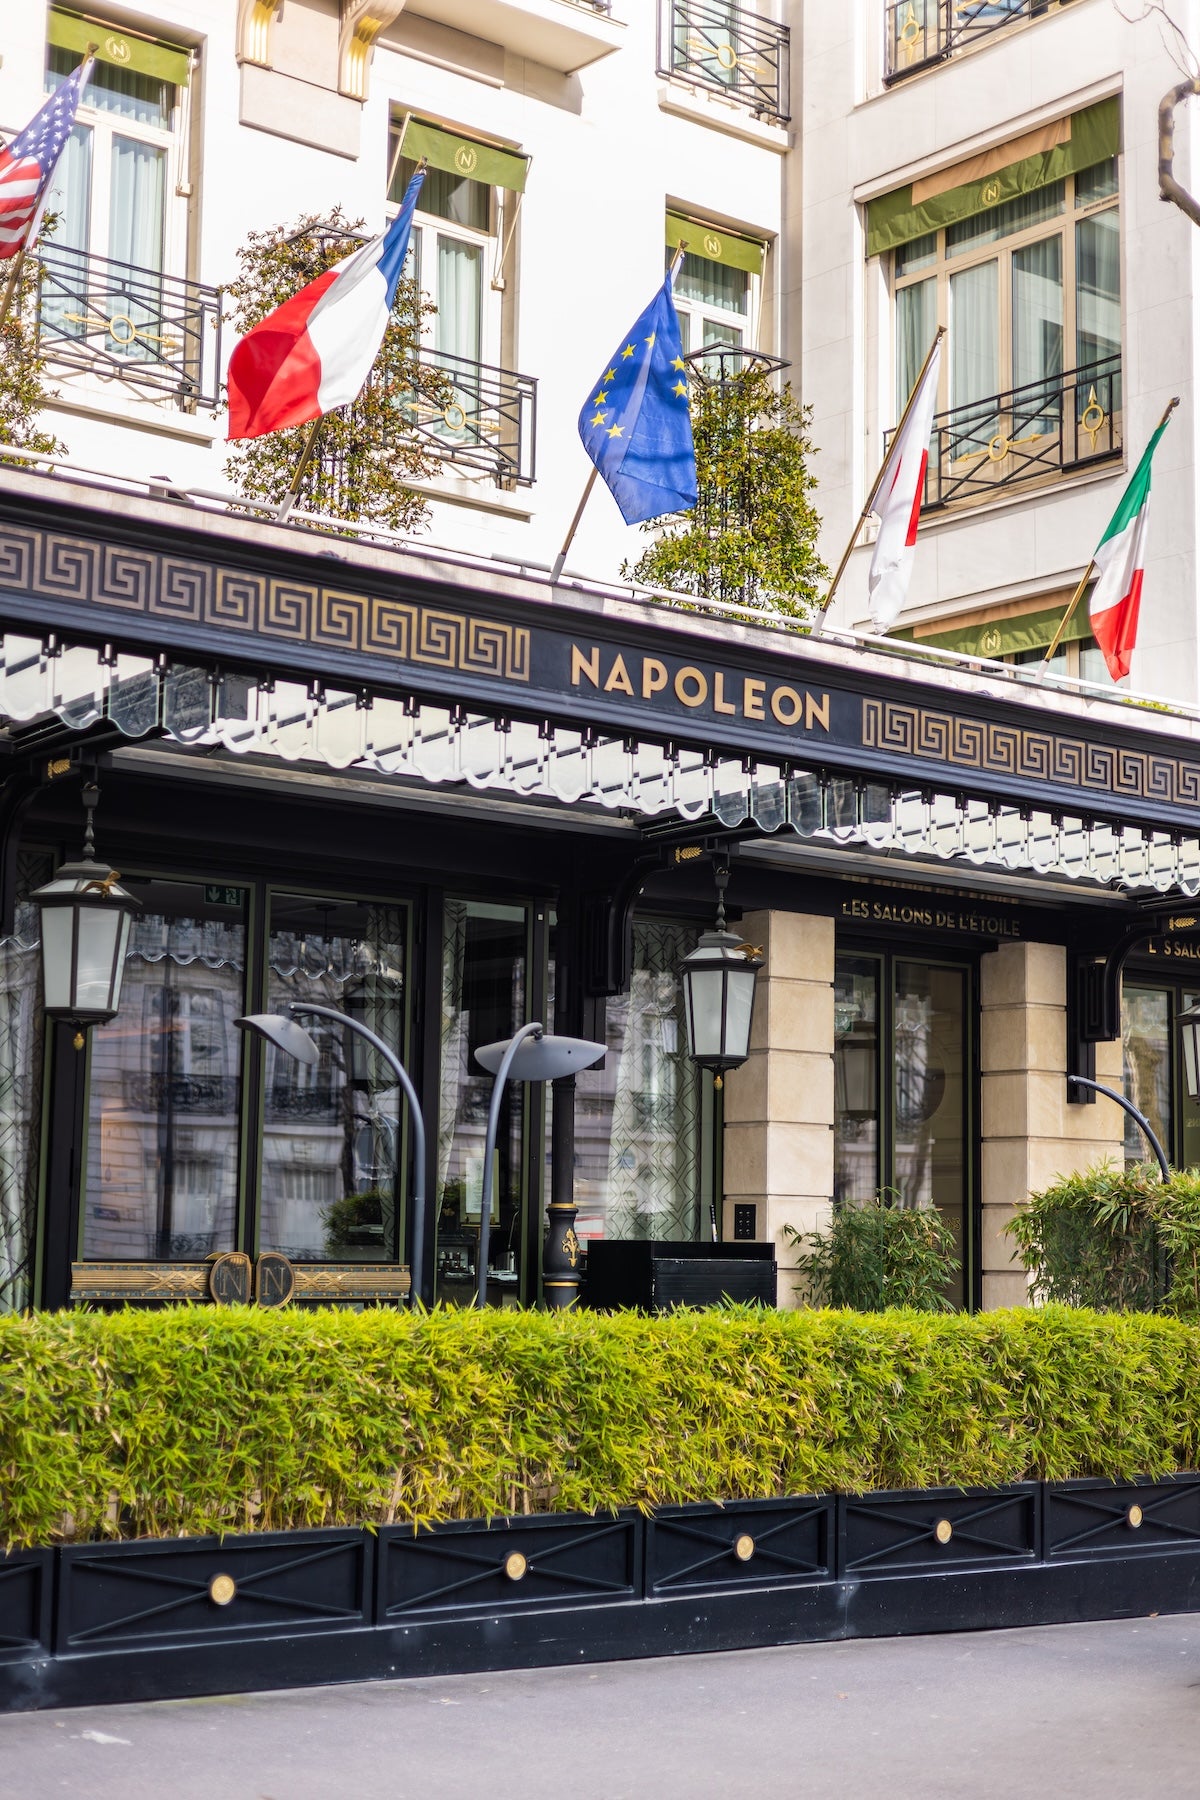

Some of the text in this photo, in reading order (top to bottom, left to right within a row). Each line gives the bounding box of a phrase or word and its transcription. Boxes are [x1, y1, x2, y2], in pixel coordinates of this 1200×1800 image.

[112, 42, 125, 58] N
[460, 152, 472, 167] N
[988, 185, 997, 201] N
[708, 240, 718, 253] N
[987, 634, 996, 649] N
[570, 643, 830, 732] NAPOLEON
[842, 899, 870, 919] LES
[873, 902, 933, 926] SALONS
[936, 911, 956, 928] DE
[1148, 936, 1172, 956] LS
[220, 1266, 245, 1296] N
[262, 1266, 286, 1296] N
